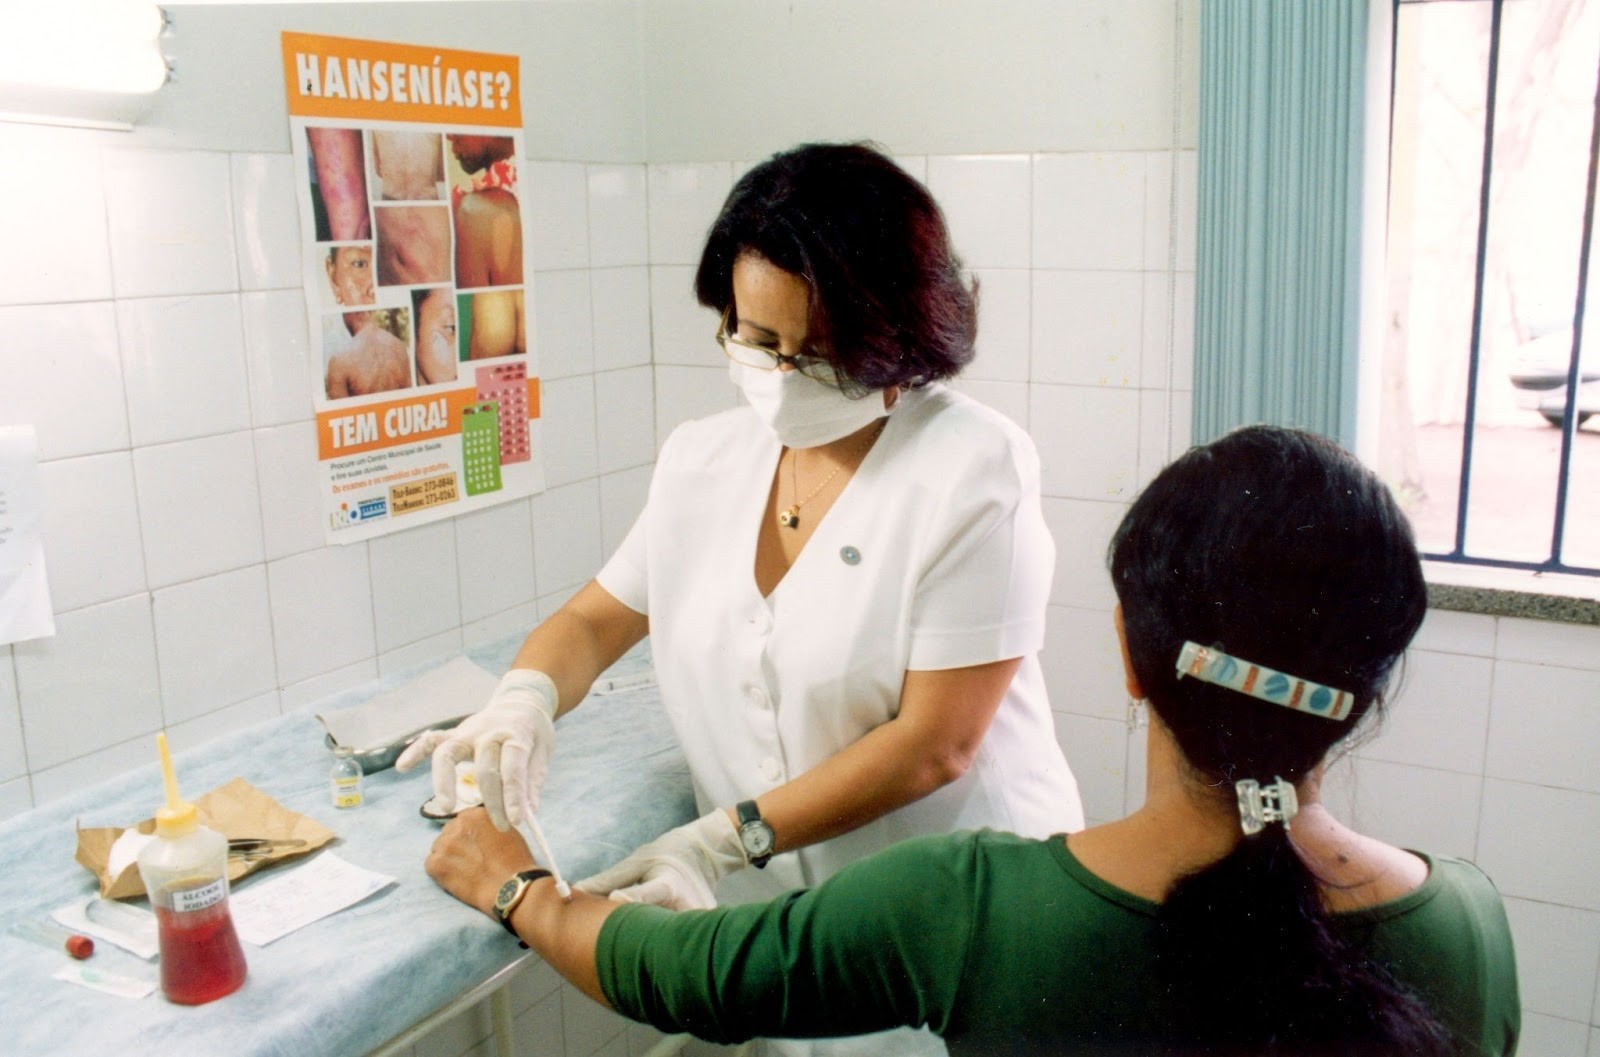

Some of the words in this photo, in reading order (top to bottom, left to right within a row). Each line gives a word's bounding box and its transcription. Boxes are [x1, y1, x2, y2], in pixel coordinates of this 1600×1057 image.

[296, 53, 511, 110] HANSENÍASE?
[329, 412, 379, 448] TEM
[384, 398, 448, 438] CURA!
